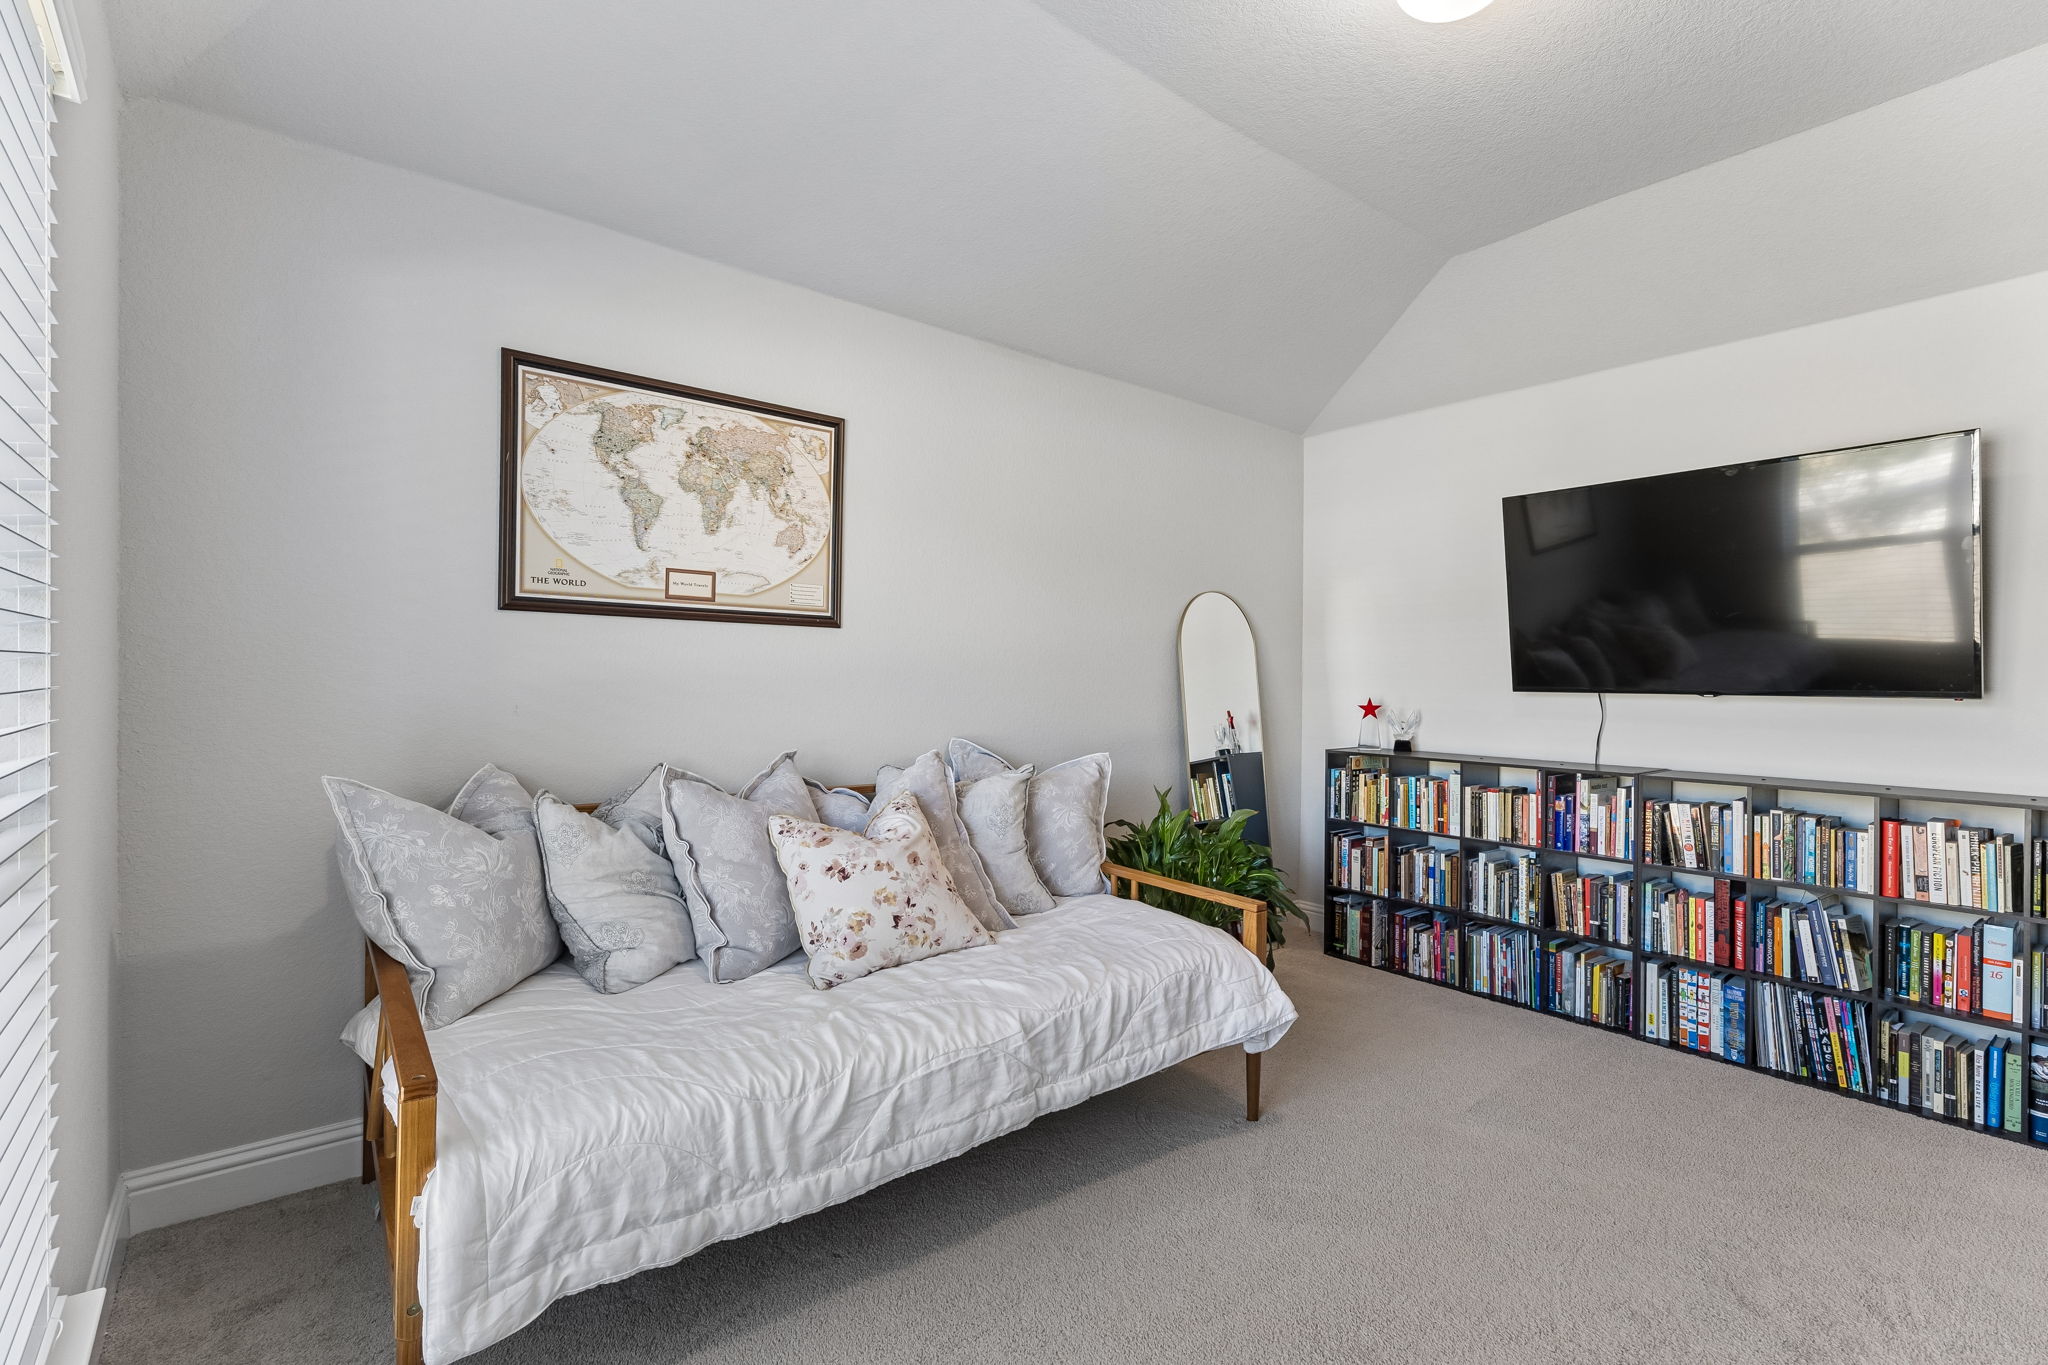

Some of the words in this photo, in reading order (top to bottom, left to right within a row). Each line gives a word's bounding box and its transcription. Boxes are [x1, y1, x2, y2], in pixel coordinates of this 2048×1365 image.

[531, 576, 549, 585] THE
[553, 577, 587, 587] WORLD
[1645, 834, 1653, 852] TEETH
[1932, 832, 1942, 865] EUROPEAN
[1933, 866, 1943, 892] FICTION
[1990, 970, 2004, 980] 16
[1819, 1027, 1833, 1062] MAUS
